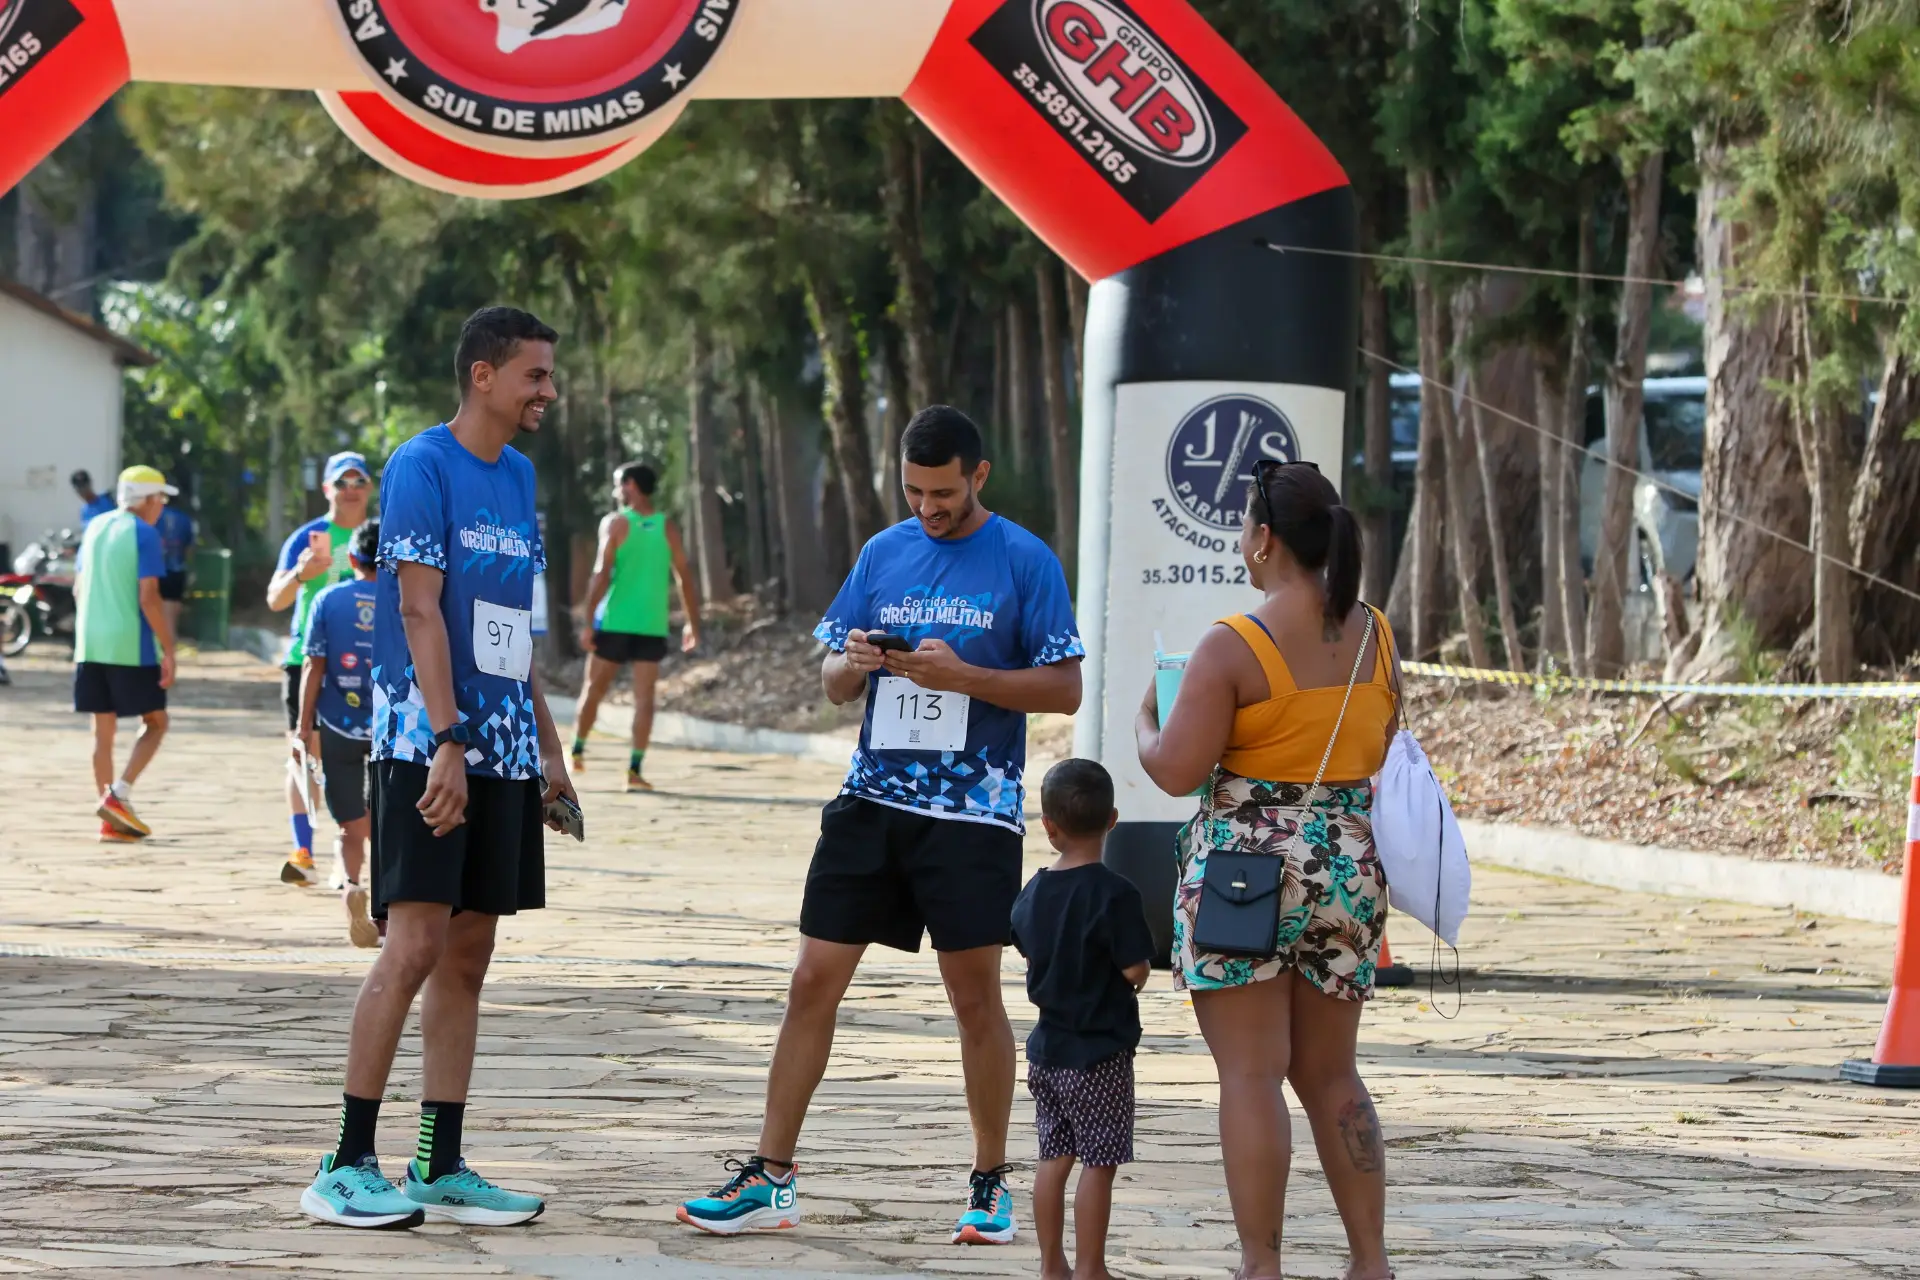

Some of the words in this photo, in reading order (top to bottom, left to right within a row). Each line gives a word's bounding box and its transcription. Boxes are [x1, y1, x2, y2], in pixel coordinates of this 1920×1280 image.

[1116, 25, 1173, 82] GRUPO
[1044, 1, 1196, 154] GHB
[421, 84, 483, 126] SUL
[491, 106, 536, 134] DE
[543, 90, 645, 134] MINAS
[1012, 62, 1138, 184] 35.3851.2165
[1152, 497, 1226, 553] ATACADO
[1142, 564, 1247, 584] 35.3015.2
[902, 595, 947, 608] Corrida
[950, 596, 968, 606] do
[880, 603, 934, 625] CÍRCULO
[935, 606, 994, 630] MILITAR
[487, 620, 514, 649] 97
[896, 693, 943, 721] 113
[332, 1181, 355, 1201] FILA
[441, 1195, 465, 1206] FILA
